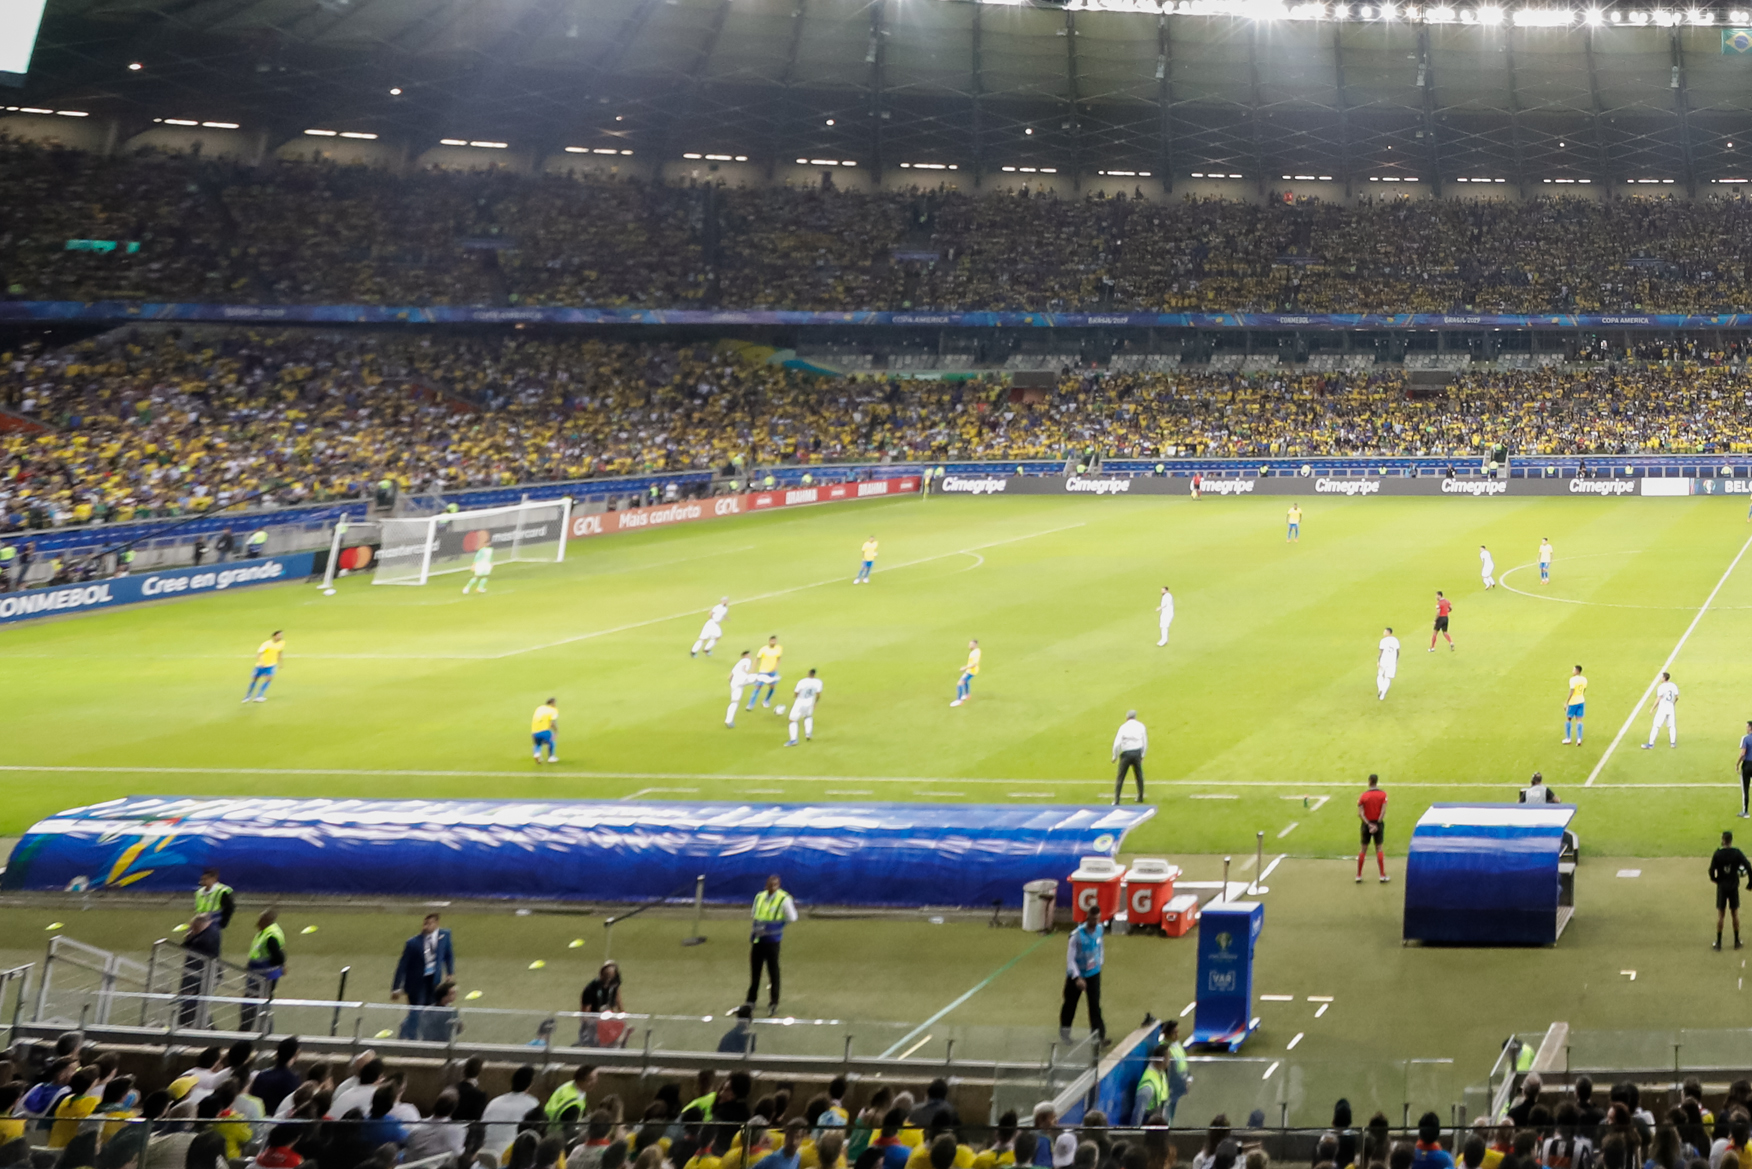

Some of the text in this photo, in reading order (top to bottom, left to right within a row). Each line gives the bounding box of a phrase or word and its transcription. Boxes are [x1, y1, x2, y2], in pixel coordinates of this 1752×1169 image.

[942, 477, 1007, 494] Cimegripe
[1066, 477, 1131, 494] Cimegripe
[1315, 478, 1380, 495] Cimegripe
[1441, 478, 1507, 495] Cimegripe
[1569, 478, 1634, 495] Cimegripe
[714, 497, 741, 515] GOL
[785, 488, 818, 506] BRAHMA
[618, 504, 702, 529] Mais conforto
[573, 516, 602, 536] GOL
[141, 575, 188, 596] Cree
[189, 571, 216, 590] en
[0, 583, 114, 618] ONMEBOL
[1665, 690, 1673, 702] 3
[1078, 888, 1098, 913] G
[1131, 888, 1152, 914] G
[1212, 974, 1232, 983] VAR
